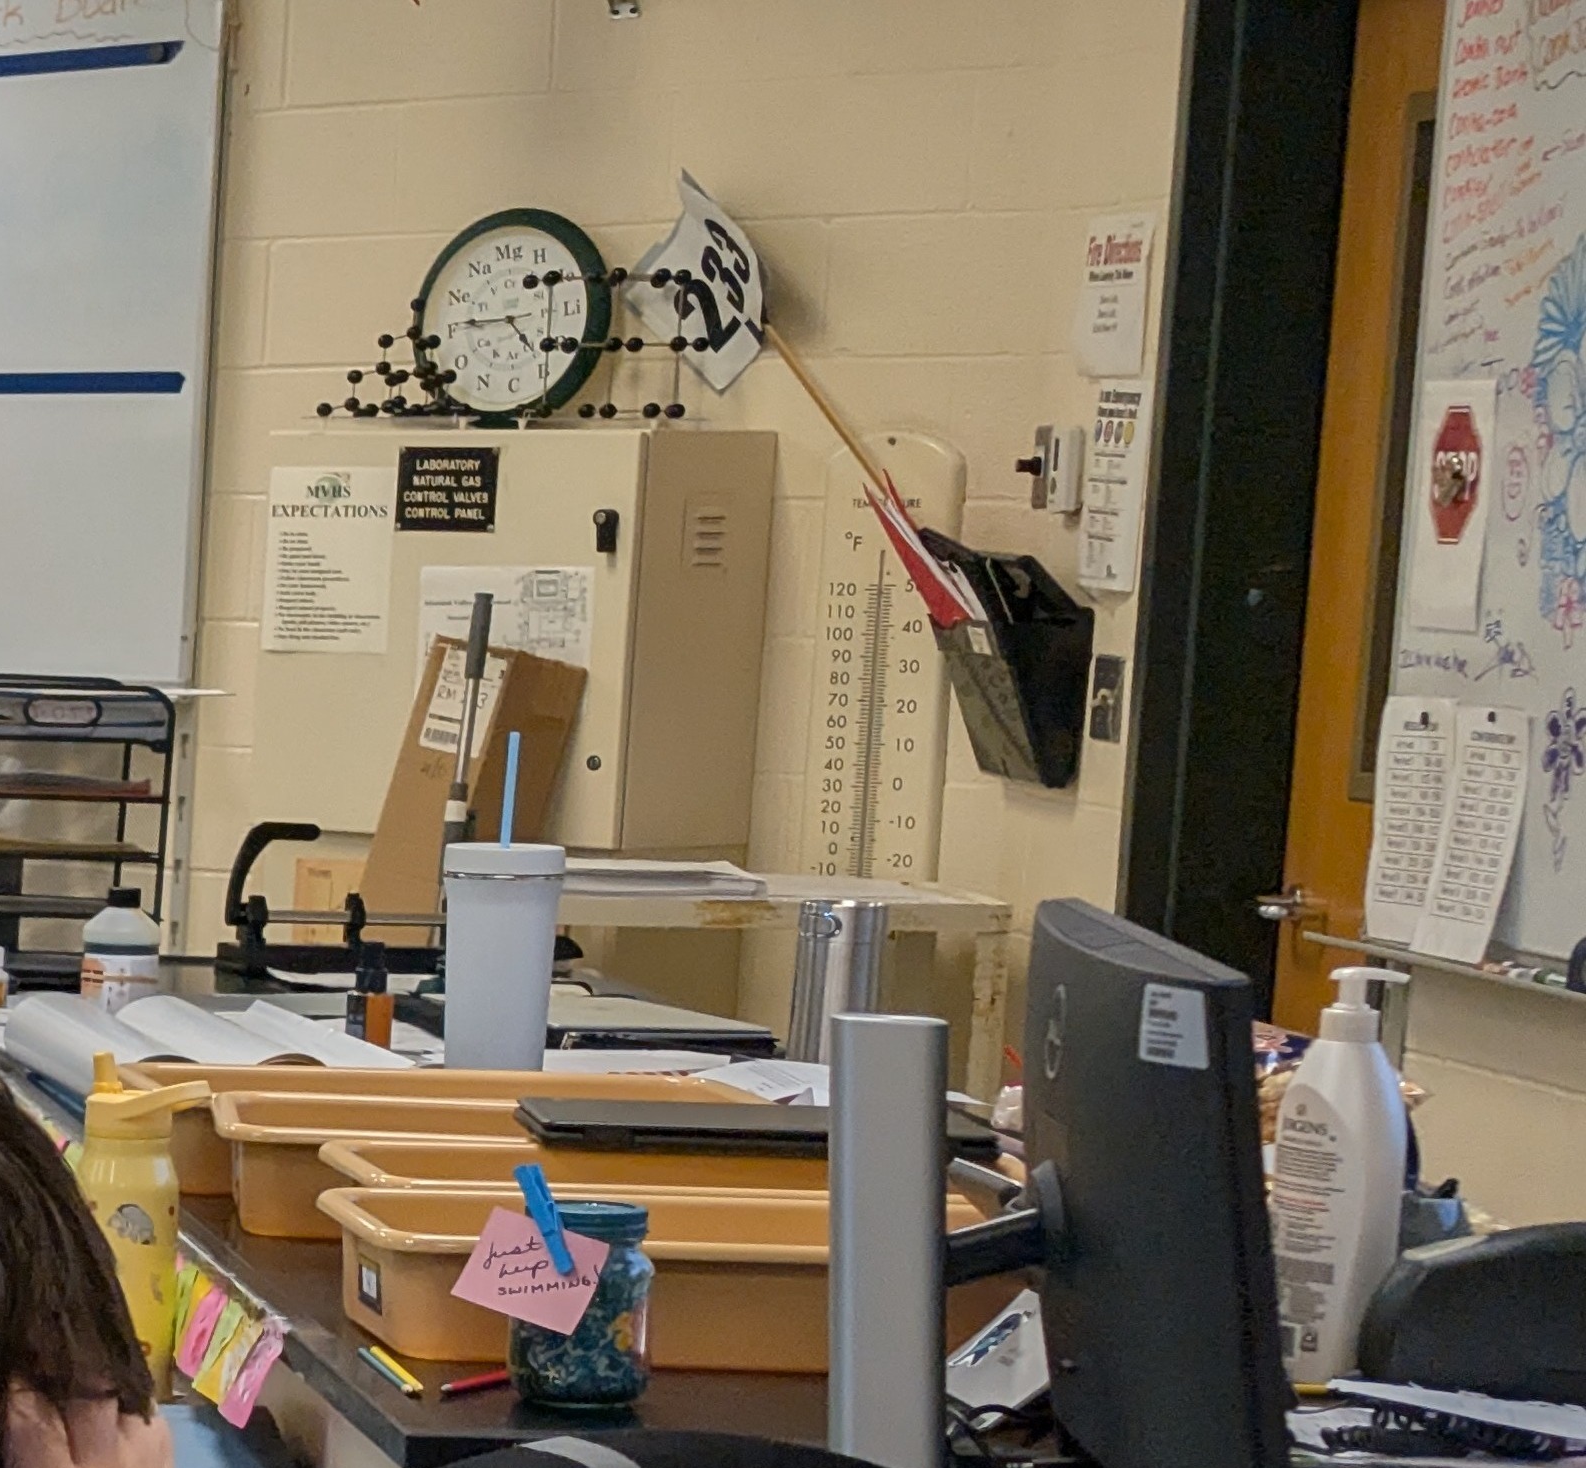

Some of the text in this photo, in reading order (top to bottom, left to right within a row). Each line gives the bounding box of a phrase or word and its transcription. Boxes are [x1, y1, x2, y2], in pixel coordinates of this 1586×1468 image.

[495, 244, 523, 261] Mg
[534, 248, 546, 264] H
[468, 261, 492, 278] Na
[448, 289, 470, 306] Ne
[563, 299, 580, 316] Li
[447, 323, 459, 339] F
[454, 354, 468, 370] O
[476, 374, 491, 391] N
[508, 378, 520, 393] C
[416, 459, 481, 471] LABORATORY
[413, 475, 482, 487] NATURAL GAS
[306, 485, 352, 499] MVHS
[404, 491, 489, 504] CONTROL VALVES
[271, 504, 388, 519] EXPECTATIONS
[405, 507, 485, 520] CONTROL PANEL
[829, 582, 857, 596] 120
[828, 605, 855, 619] 110
[902, 619, 923, 634] 40
[826, 627, 853, 641] 100
[832, 650, 852, 663] 90
[899, 659, 920, 673] 30
[830, 671, 850, 685] 80
[828, 693, 849, 707] 70
[896, 699, 917, 713] 20
[827, 715, 847, 728] 60
[825, 736, 845, 750] 50
[896, 738, 914, 752] 10
[824, 758, 844, 771] 40
[822, 779, 843, 793] 30
[893, 777, 903, 791] 0
[821, 800, 841, 814] 20
[821, 821, 840, 834] 10
[889, 816, 916, 830] -10
[828, 842, 838, 855] 0
[887, 854, 913, 868] -20
[810, 862, 836, 876] -10
[483, 1236, 542, 1270] Just
